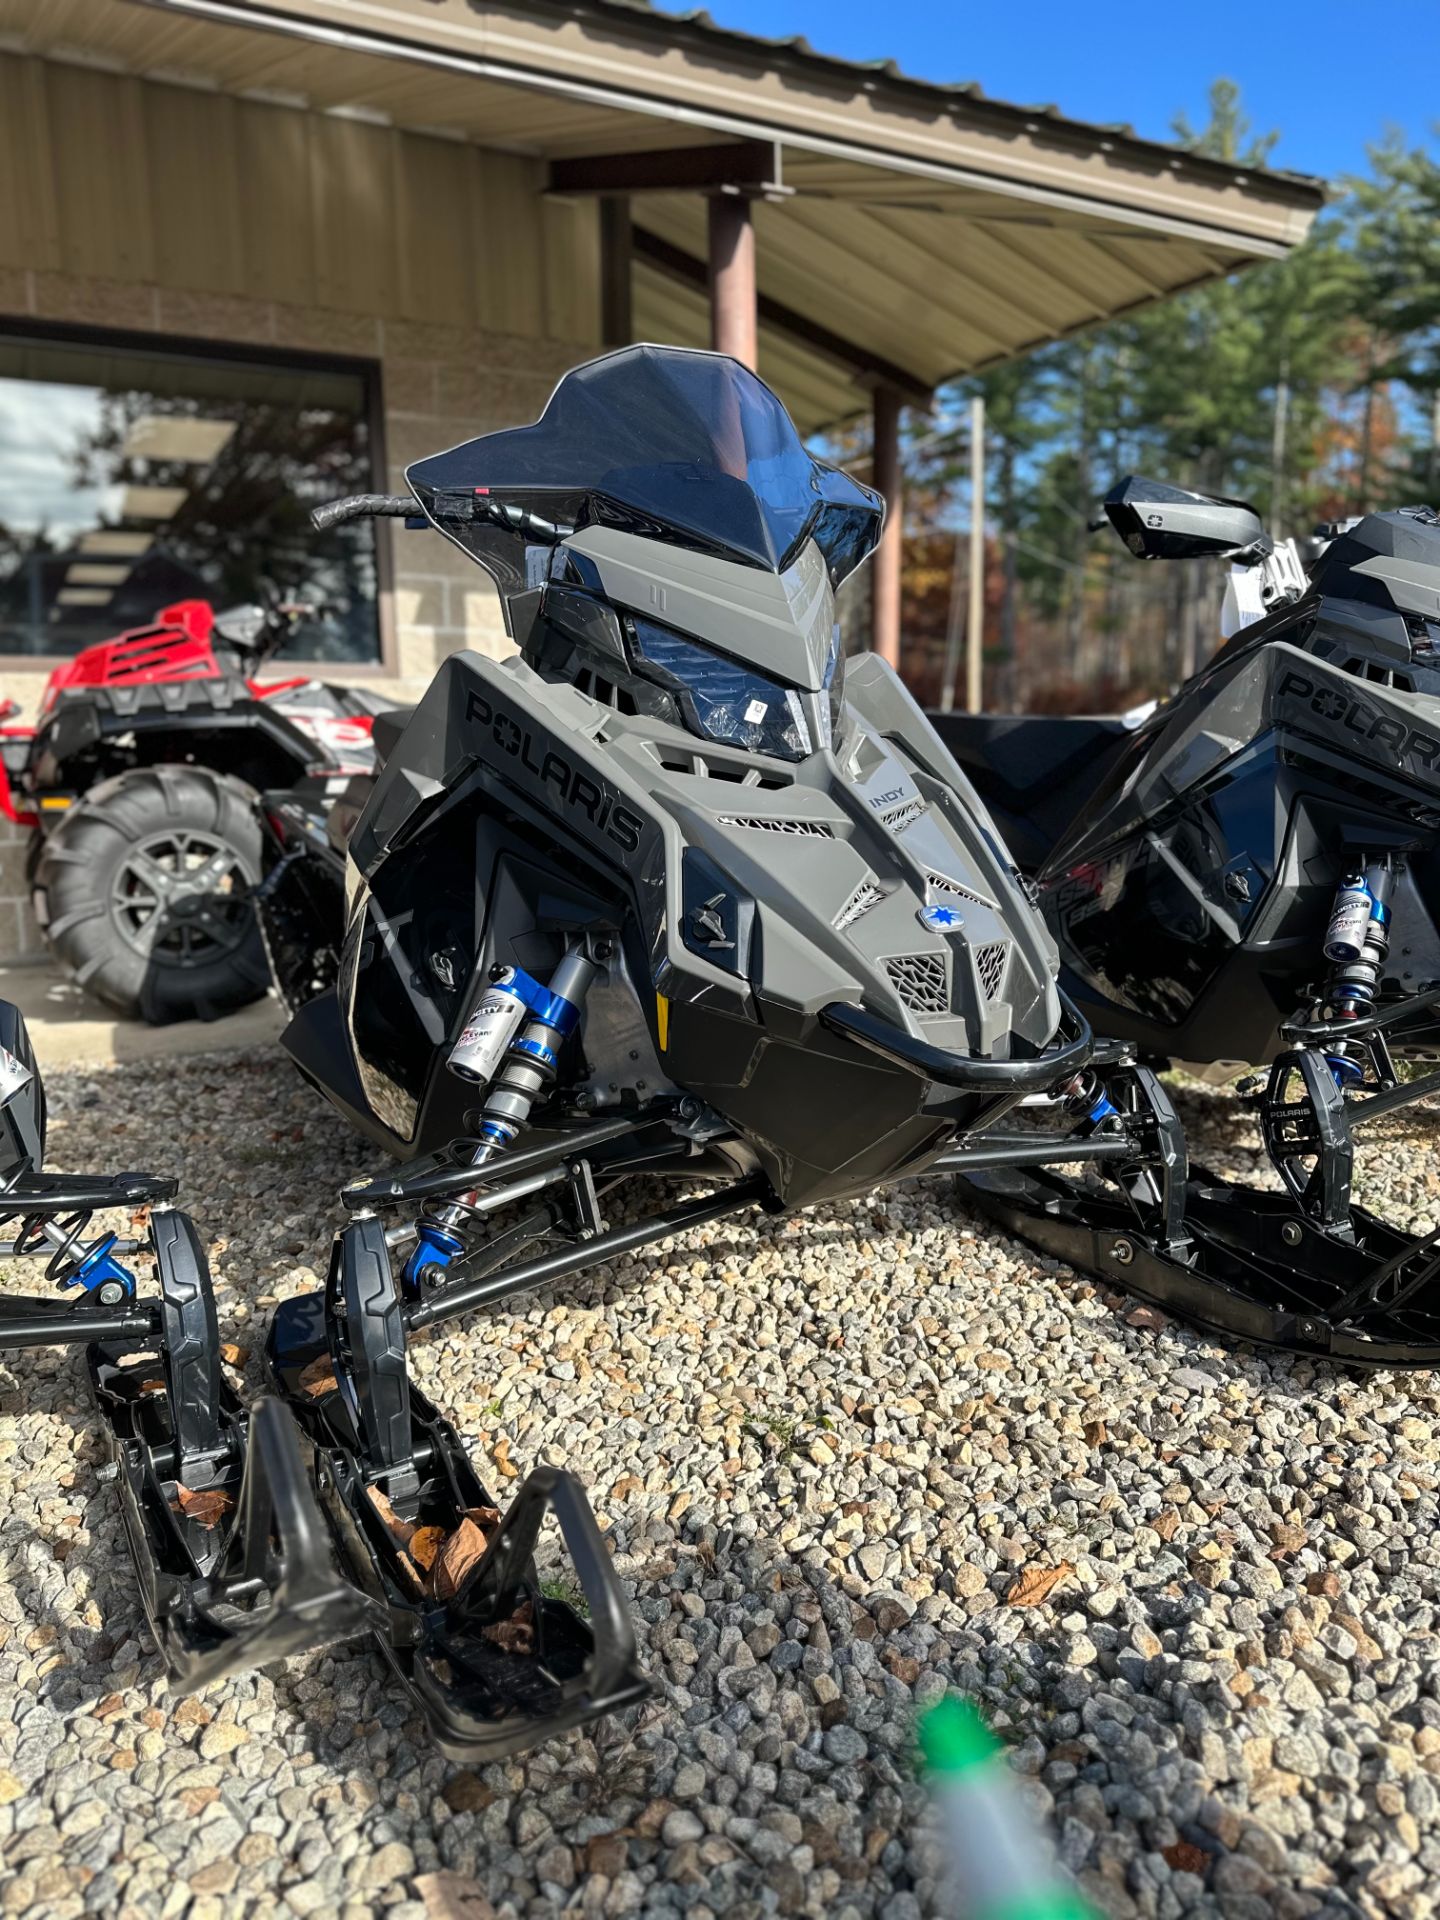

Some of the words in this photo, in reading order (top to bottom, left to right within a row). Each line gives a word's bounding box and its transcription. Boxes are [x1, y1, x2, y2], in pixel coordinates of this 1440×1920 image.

[1278, 672, 1440, 770] POLAR
[466, 691, 645, 852] POLARIS
[869, 788, 904, 808] INDY
[1271, 1108, 1311, 1118] POLARIS
